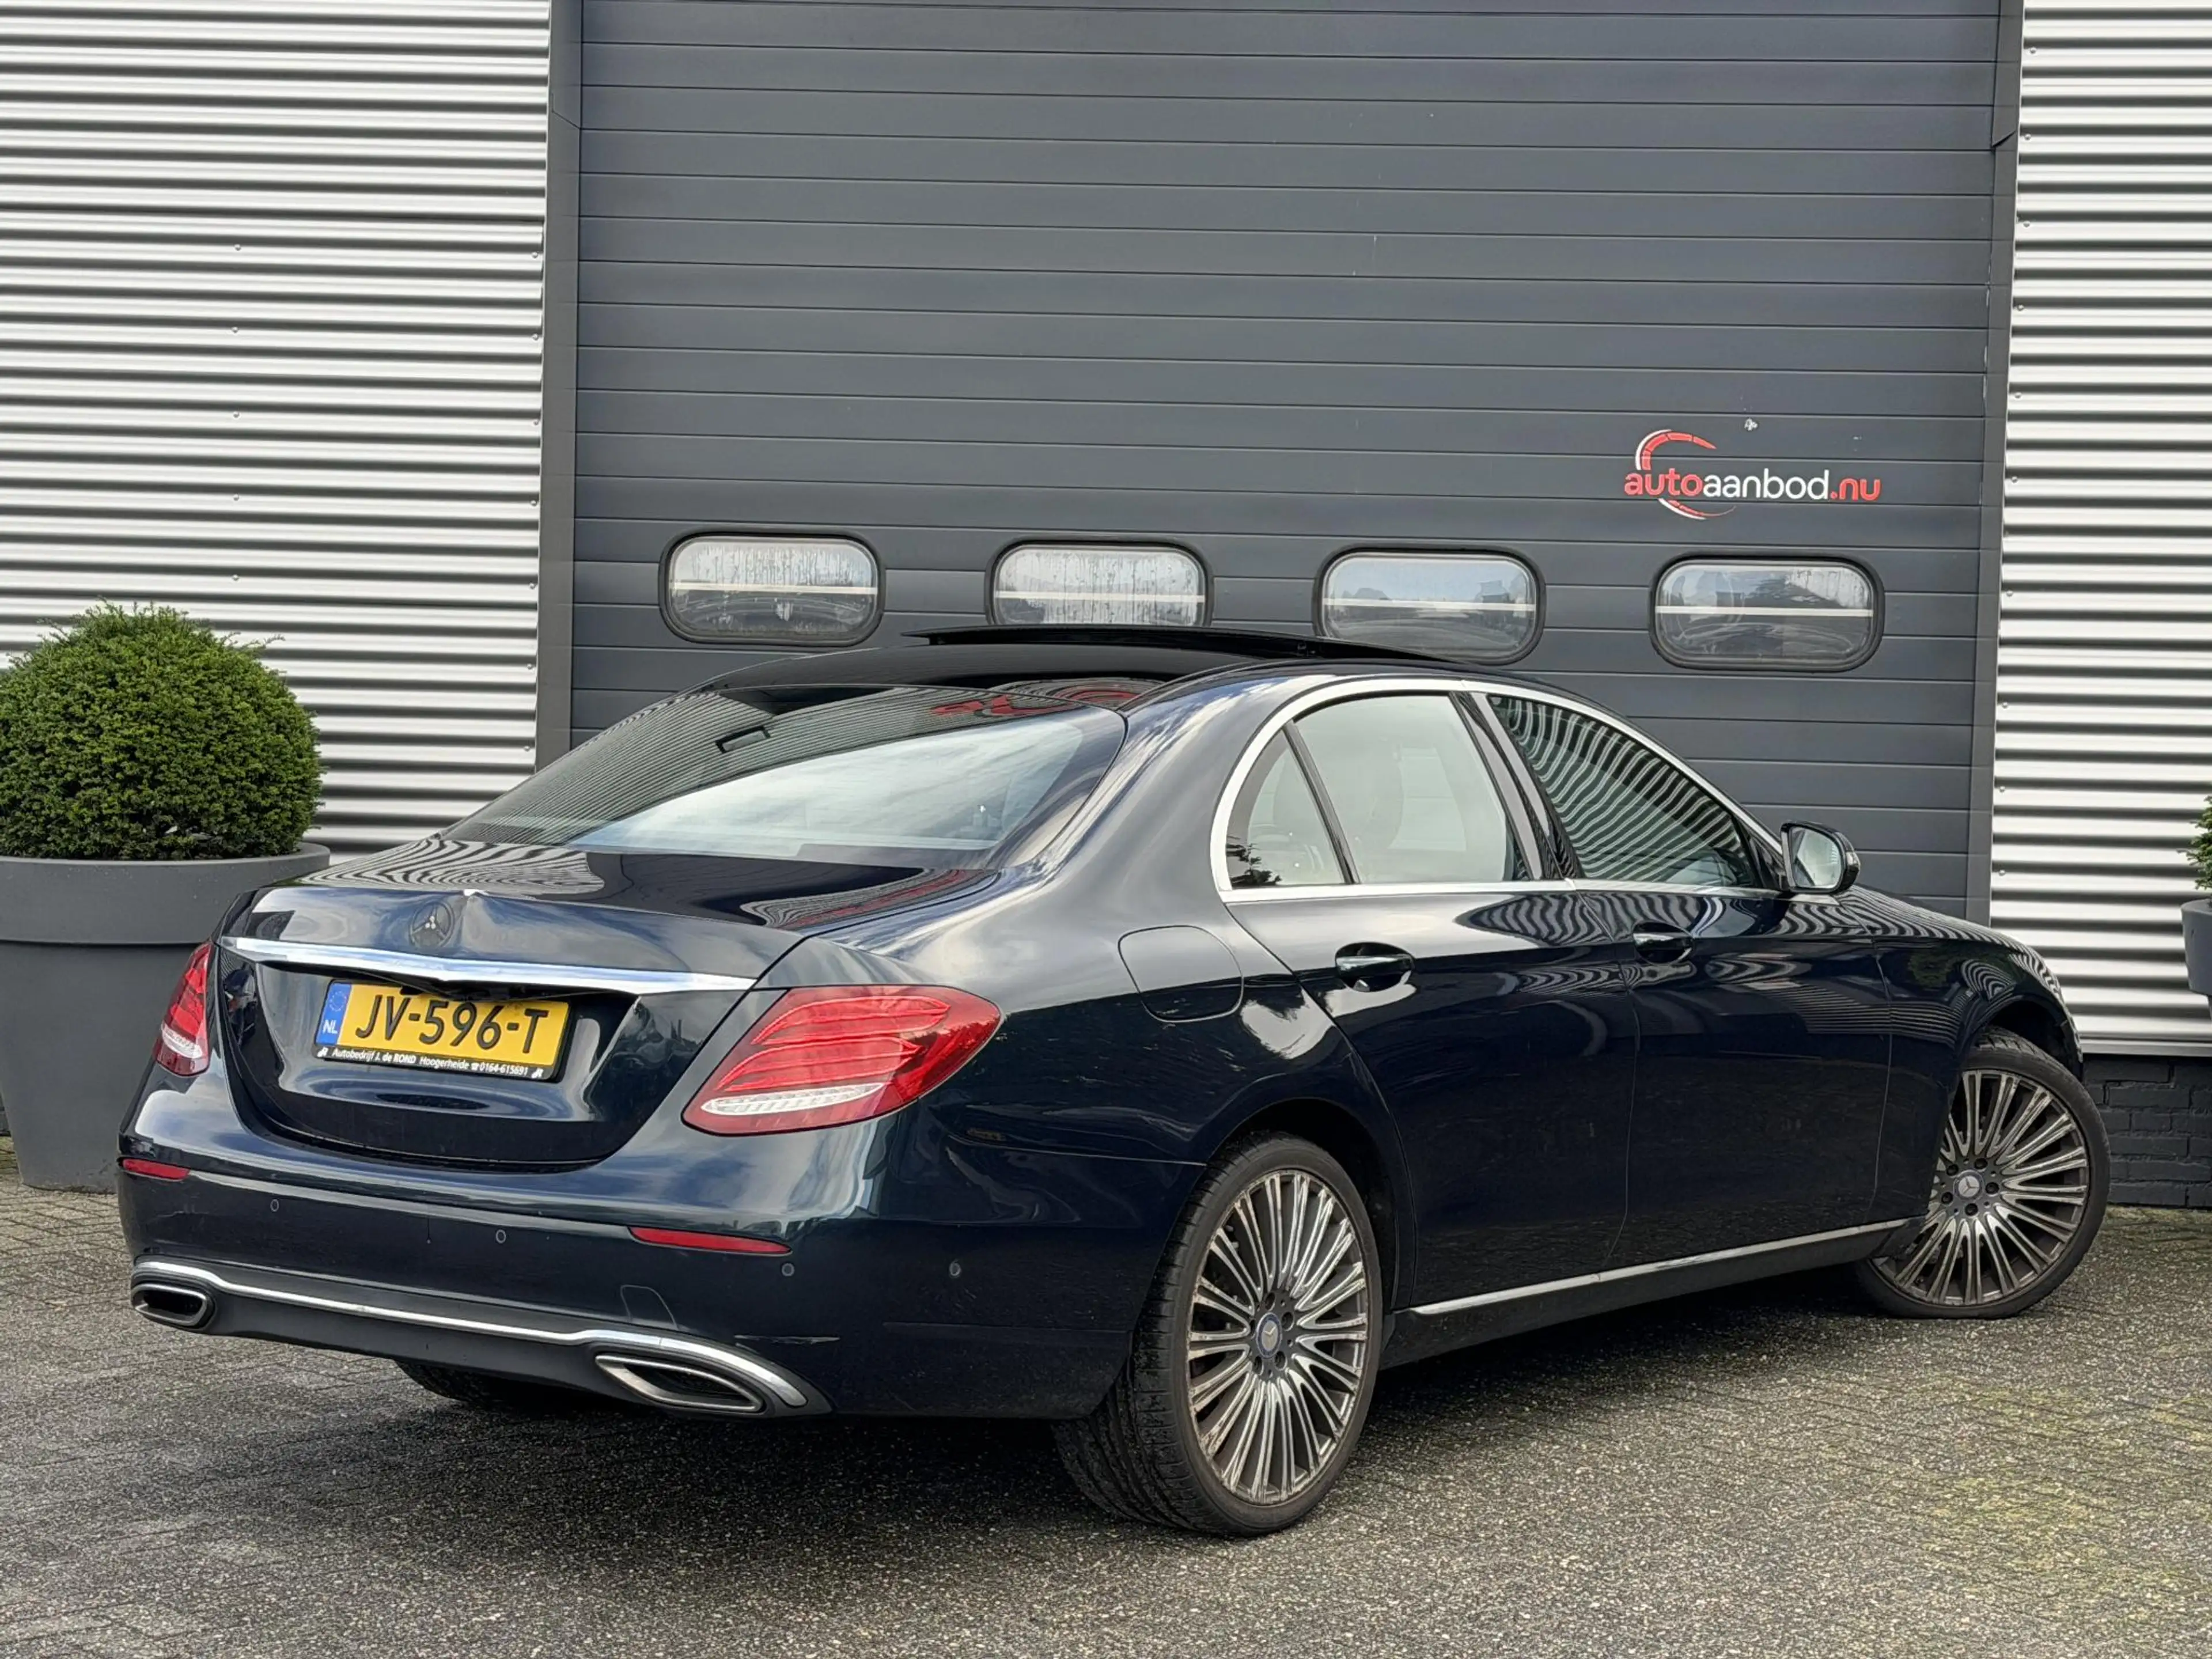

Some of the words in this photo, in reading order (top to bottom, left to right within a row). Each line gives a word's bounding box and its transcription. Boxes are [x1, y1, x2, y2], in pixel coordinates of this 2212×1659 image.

[1624, 468, 1881, 501] autoaanbod.nu
[323, 1019, 338, 1035] NL
[355, 994, 548, 1054] JV-596-T
[332, 1048, 374, 1062] Autobedrijf
[382, 1052, 392, 1062] de
[393, 1054, 416, 1064] ROND
[419, 1056, 469, 1070] Hoogerheide
